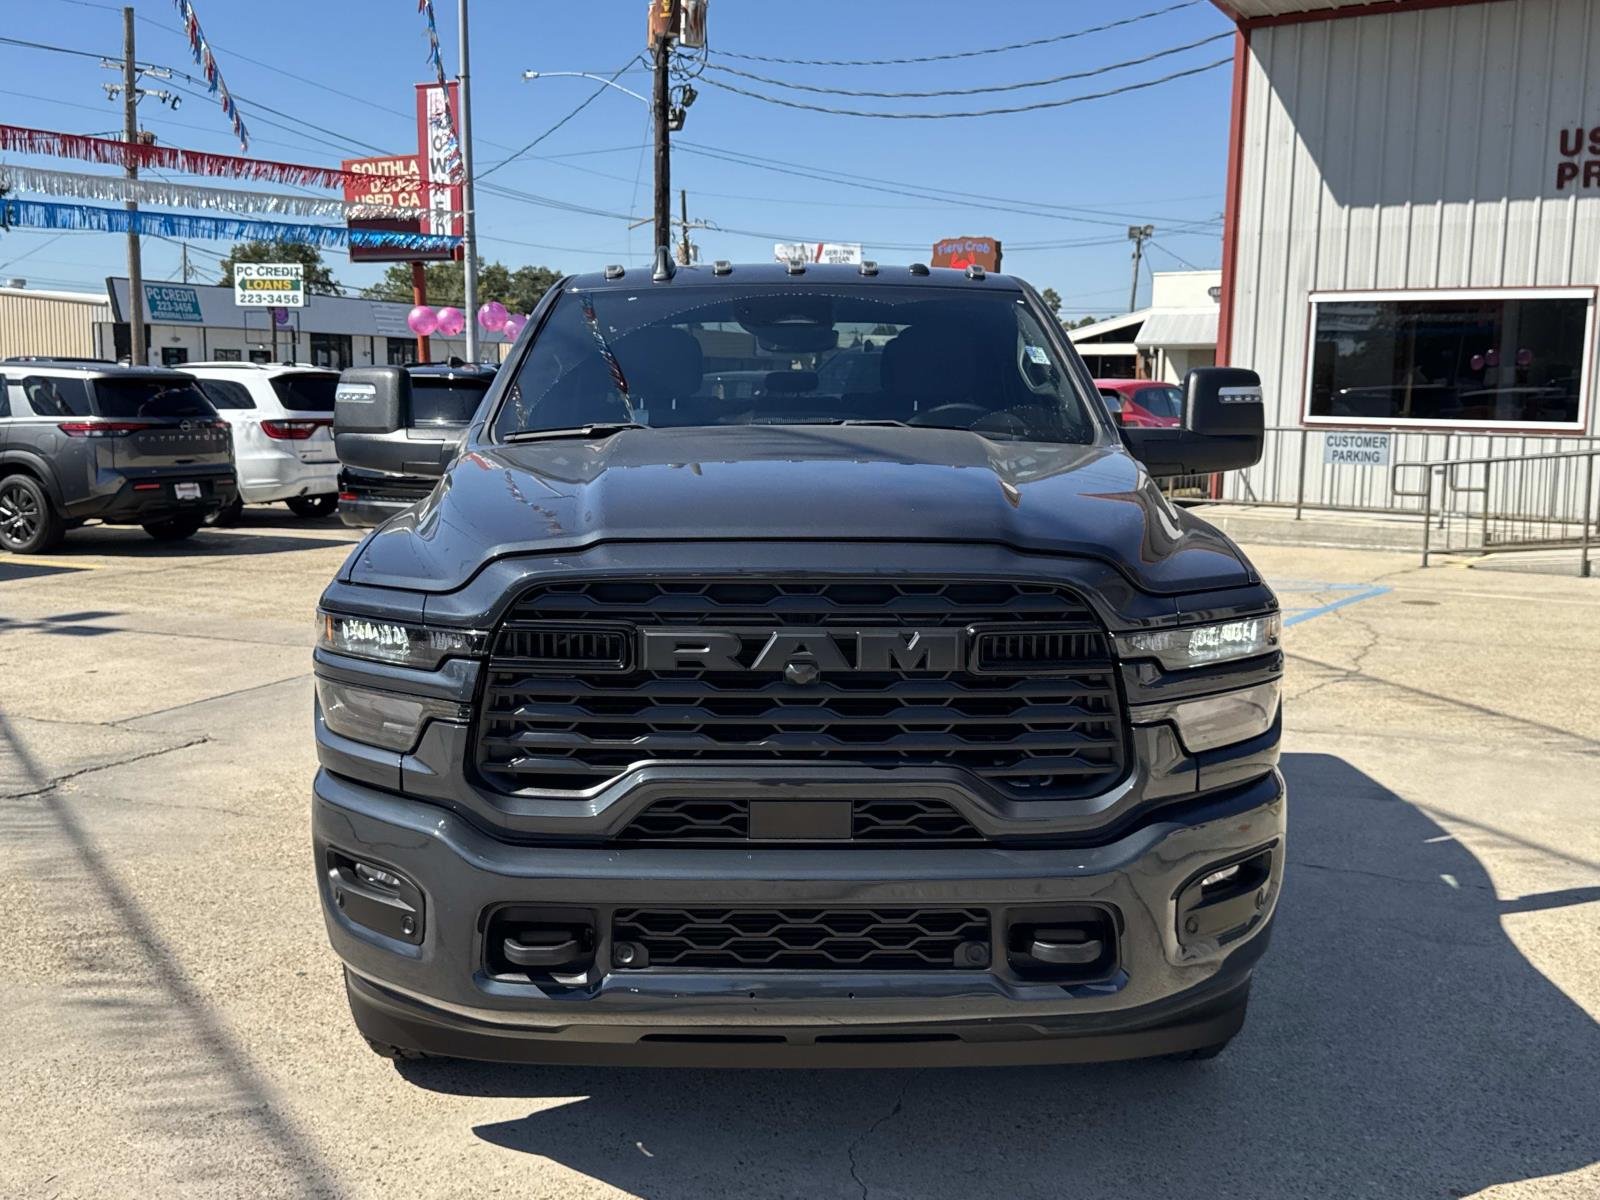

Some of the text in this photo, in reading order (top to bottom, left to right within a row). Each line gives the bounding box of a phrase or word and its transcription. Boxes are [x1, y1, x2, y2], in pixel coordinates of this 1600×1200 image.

[236, 266, 301, 277] PC CREDIT
[246, 280, 292, 290] LOANS
[146, 287, 195, 303] PC CREDIT
[240, 294, 300, 304] 223-3456
[1326, 435, 1388, 448] CUSTOMER
[1331, 450, 1380, 463] PARKING
[638, 627, 964, 672] RAM
